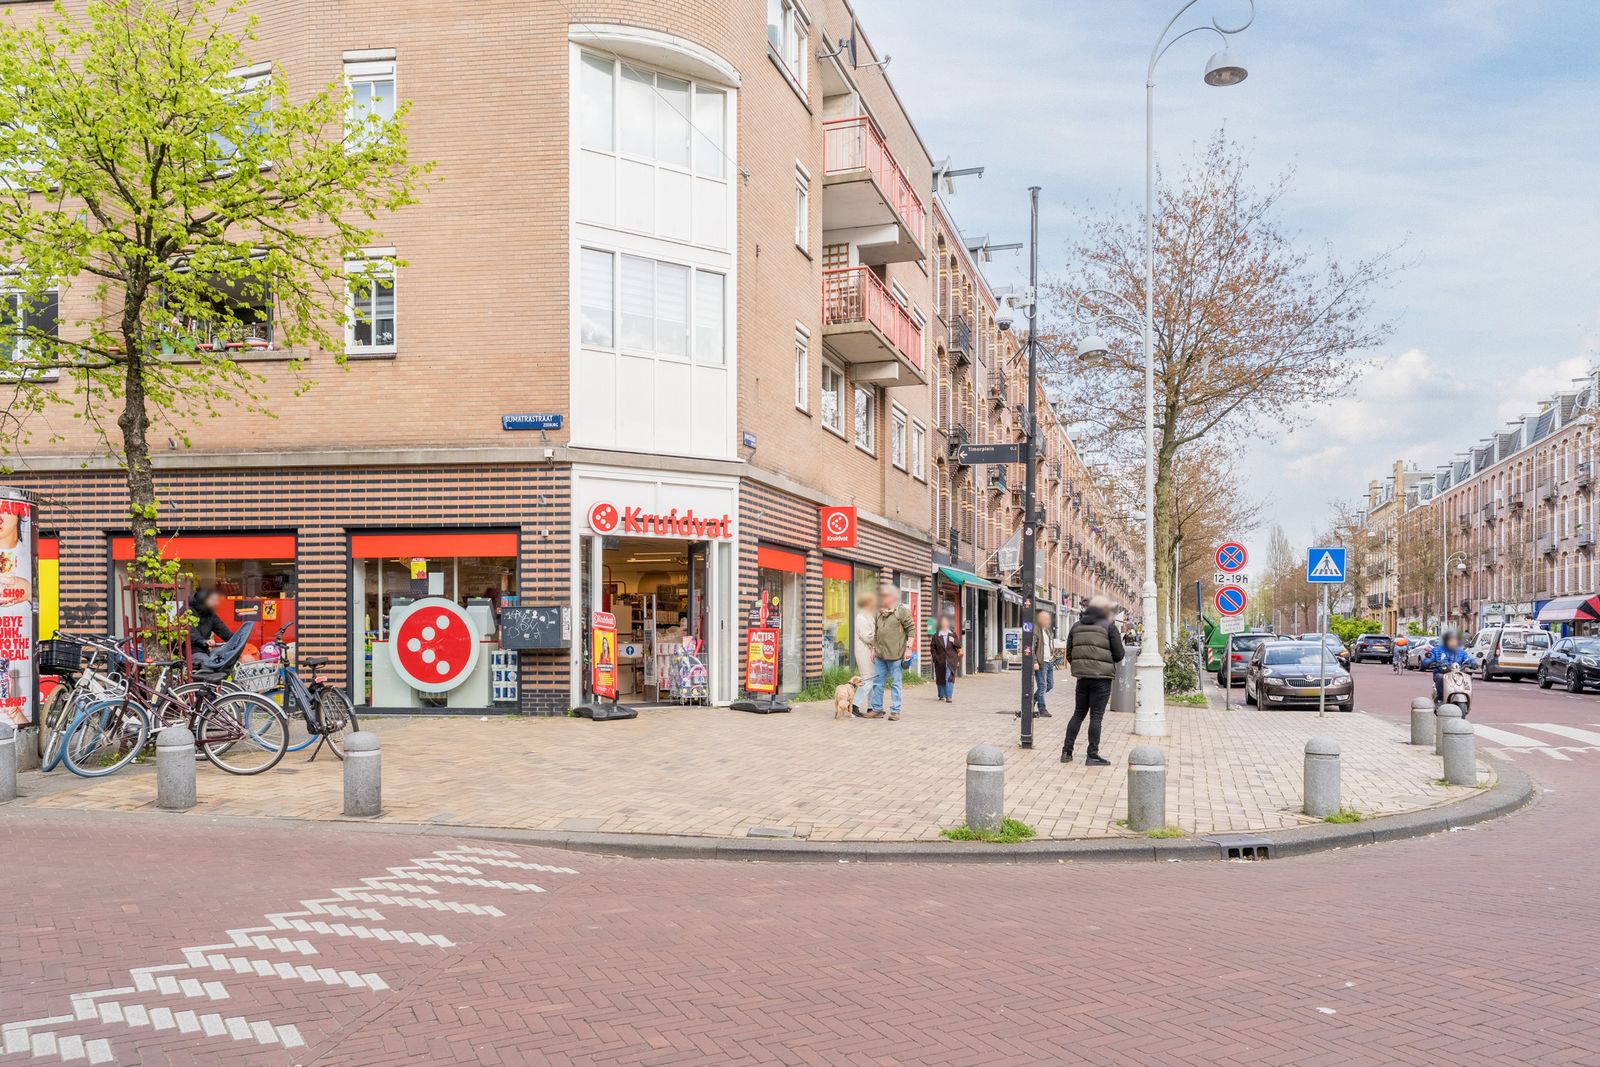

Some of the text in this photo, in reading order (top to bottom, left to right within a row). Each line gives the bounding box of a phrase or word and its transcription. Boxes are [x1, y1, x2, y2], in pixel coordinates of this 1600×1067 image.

[505, 415, 553, 423] SUMATRASTRAAT
[624, 506, 733, 538] Kruidvat
[3, 588, 25, 598] SHOP
[751, 631, 775, 642] ACTIE!
[12, 638, 29, 650] THE
